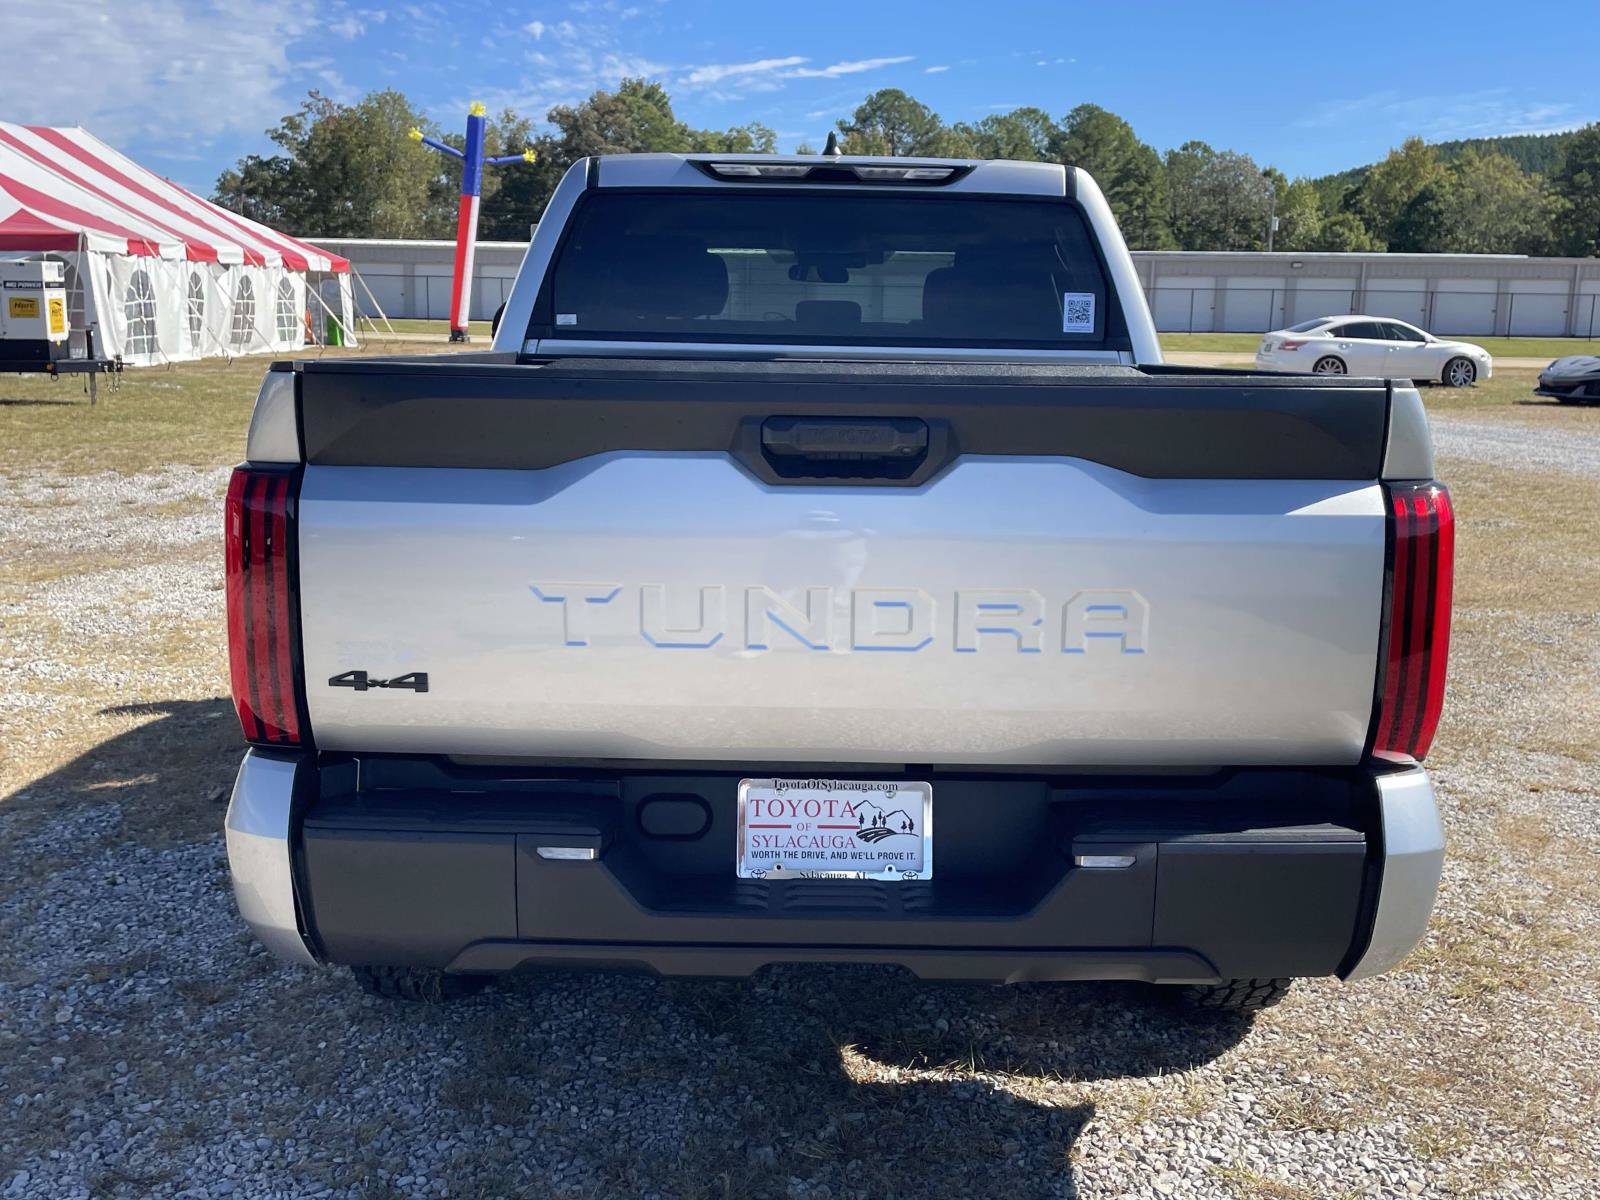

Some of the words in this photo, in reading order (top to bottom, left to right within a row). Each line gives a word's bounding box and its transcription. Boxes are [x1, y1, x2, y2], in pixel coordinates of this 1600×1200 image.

[528, 582, 1151, 654] TUNDRA
[328, 670, 429, 693] 4x4
[772, 779, 898, 792] ToyotaOfSylacauga.com
[750, 799, 857, 818] TOYOTA
[796, 822, 812, 832] OF
[751, 834, 857, 849] SYLACAUGA
[751, 850, 781, 859] WORTH
[783, 850, 798, 859] THE
[801, 851, 828, 861] DRIVE,
[830, 851, 848, 860] AND
[851, 852, 875, 860] WE'LL
[877, 852, 904, 860] PROVE
[906, 852, 917, 861] IT.
